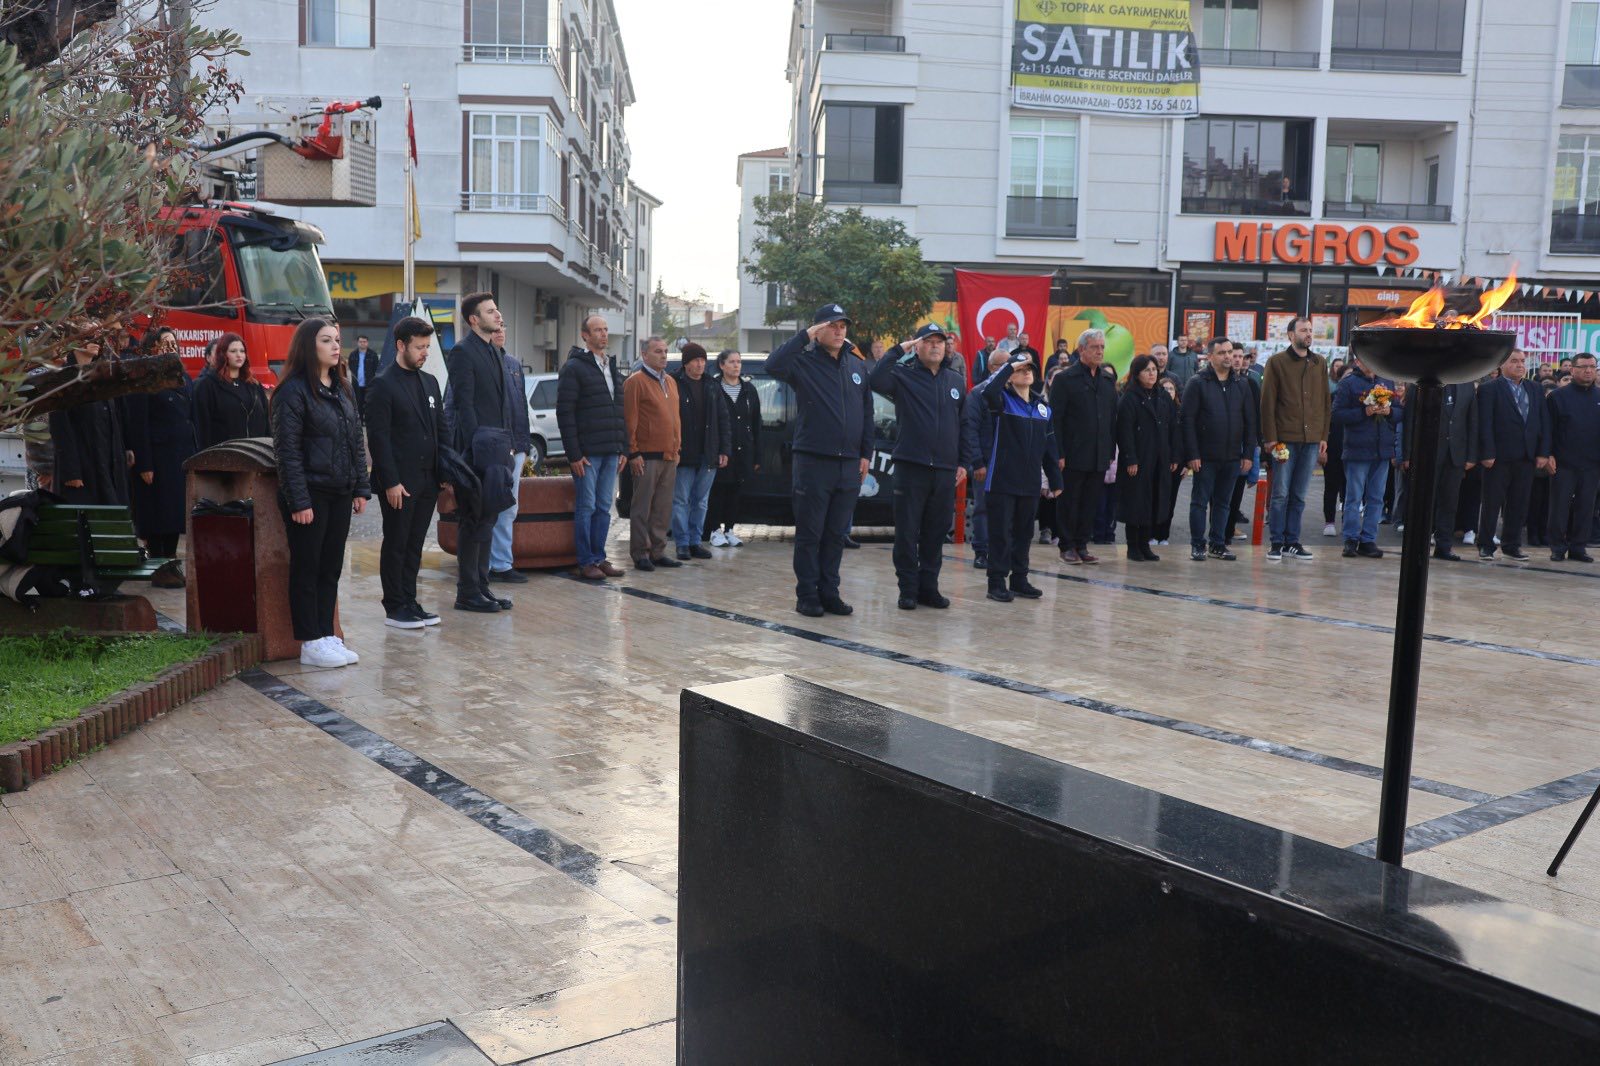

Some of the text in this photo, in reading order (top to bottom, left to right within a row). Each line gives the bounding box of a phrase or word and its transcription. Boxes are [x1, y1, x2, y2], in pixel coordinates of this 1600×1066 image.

[1061, 2, 1105, 14] TOPRAK
[1021, 23, 1192, 70] SATILIK
[1020, 62, 1036, 73] 2+1
[1040, 64, 1051, 74] 15
[1053, 65, 1076, 76] ADET
[1078, 68, 1106, 79] CEPHE
[1108, 70, 1155, 81] SEÇENEKLİ
[1117, 97, 1142, 110] 0532
[1146, 99, 1164, 111] 156
[1166, 99, 1178, 111] 54
[1180, 99, 1193, 111] 02
[328, 271, 358, 293] Ptt
